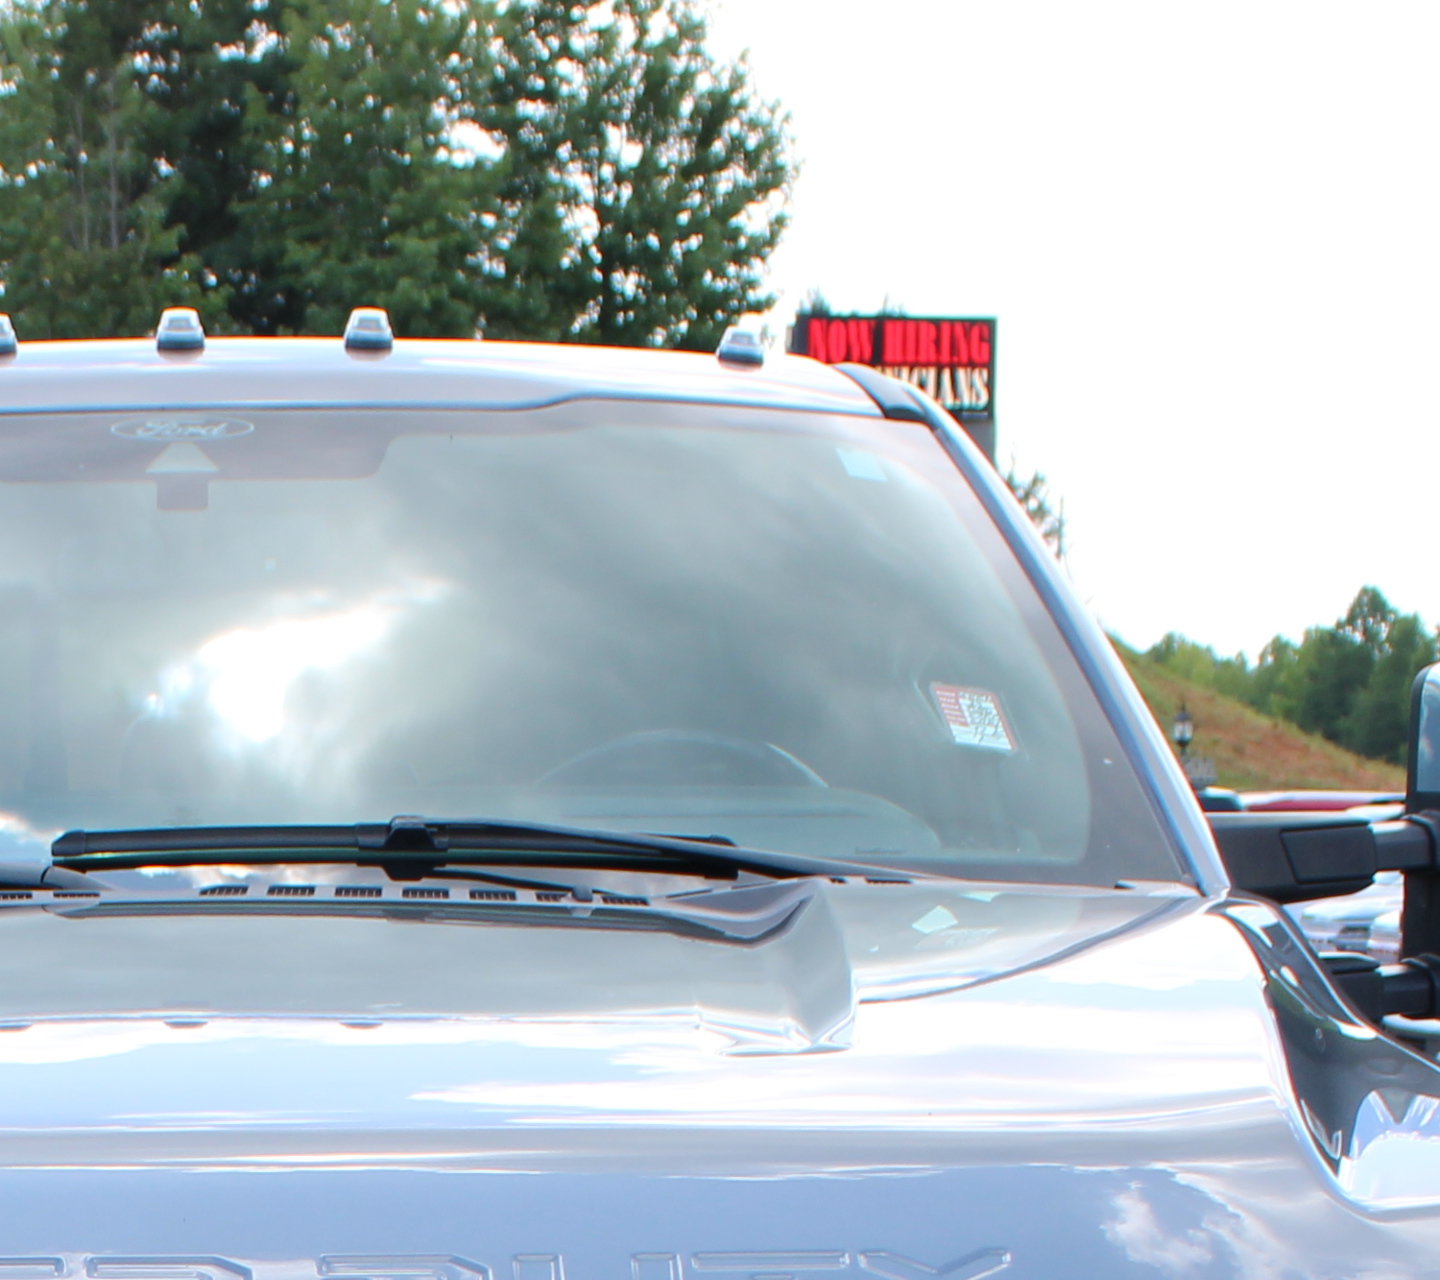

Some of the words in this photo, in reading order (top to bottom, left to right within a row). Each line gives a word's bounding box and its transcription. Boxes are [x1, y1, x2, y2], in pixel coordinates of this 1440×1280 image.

[808, 318, 877, 365] NOW
[883, 318, 991, 364] HIRING
[135, 419, 229, 438] Ford
